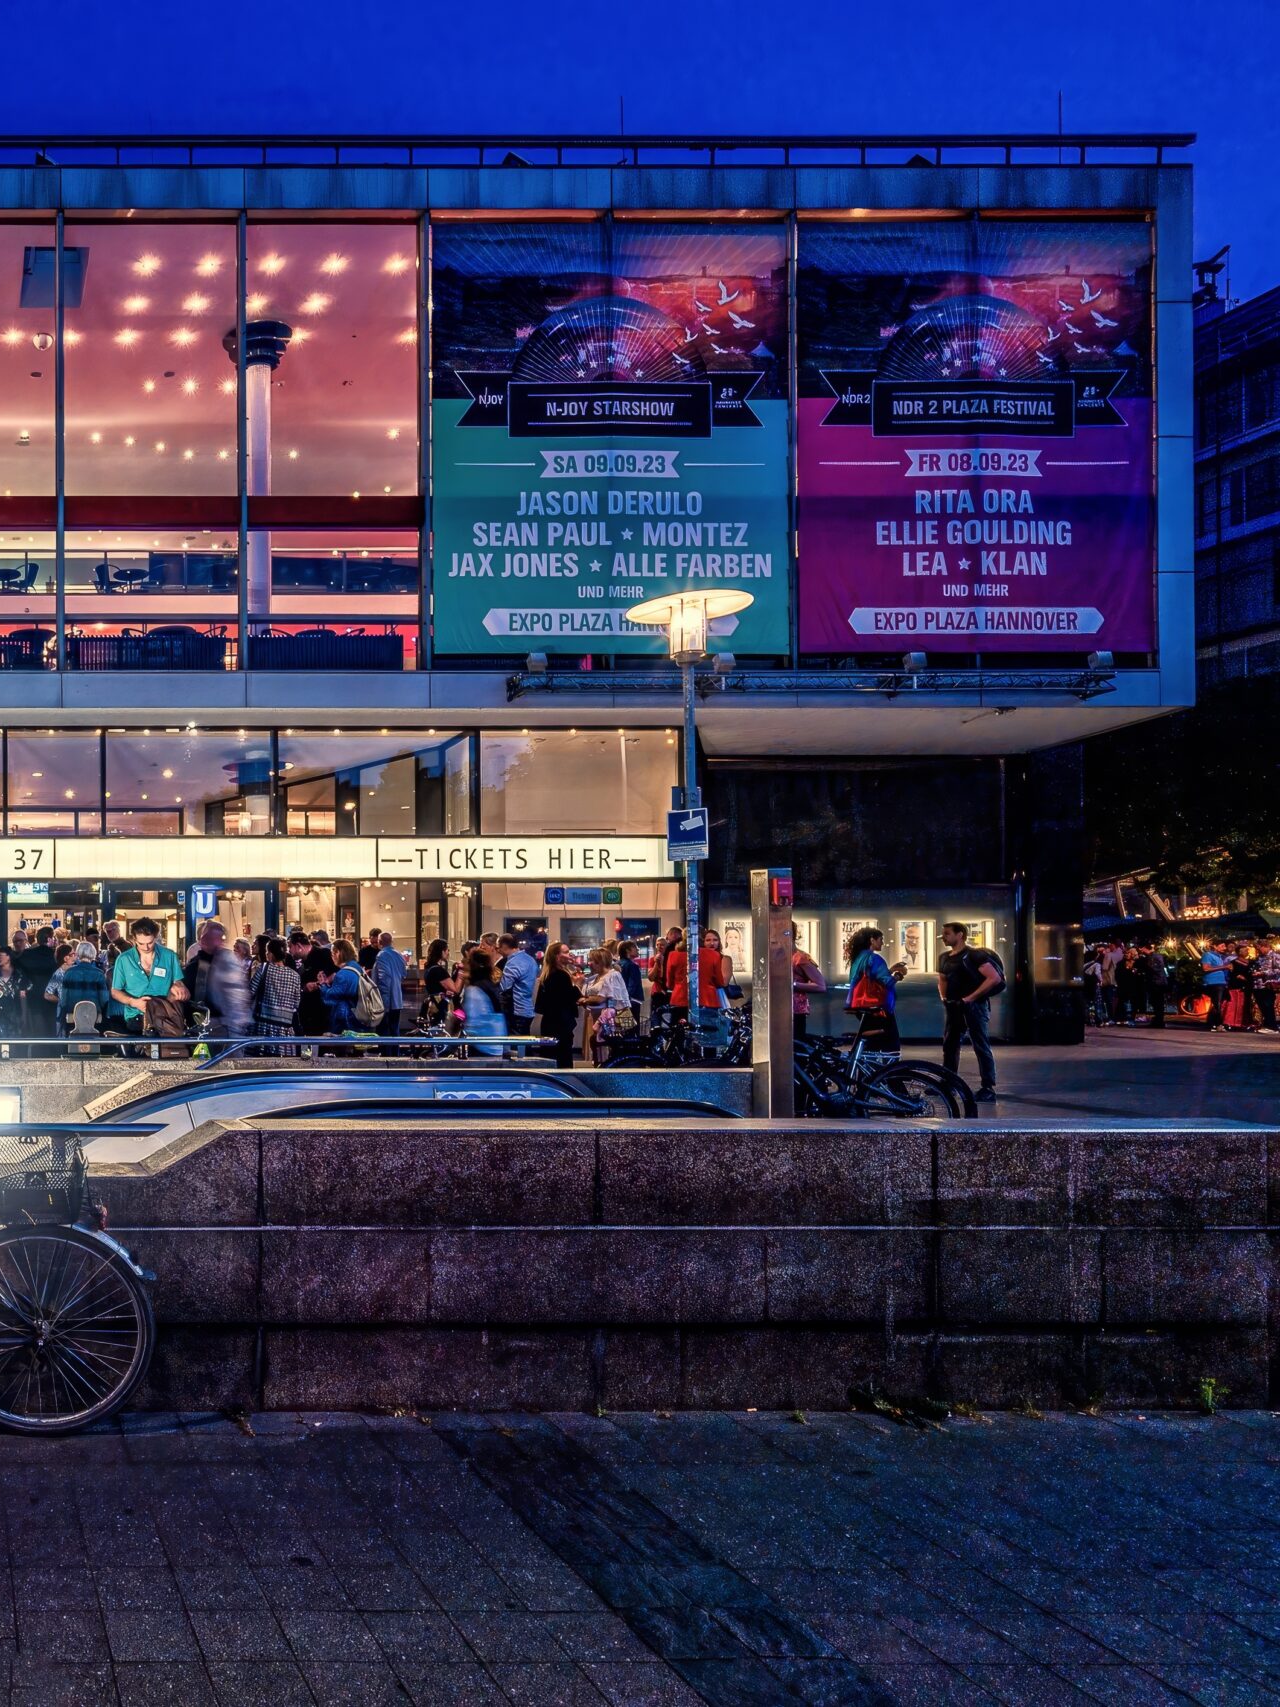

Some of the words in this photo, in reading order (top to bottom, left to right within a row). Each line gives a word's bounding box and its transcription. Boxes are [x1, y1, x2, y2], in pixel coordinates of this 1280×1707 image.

[546, 401, 588, 417] N-JOY
[593, 401, 675, 417] STARSHOW
[892, 400, 924, 416] NDR
[928, 400, 938, 415] 2
[942, 400, 989, 415] PLAZA
[993, 400, 1055, 416] FESTIVAL
[552, 456, 578, 473] SA
[584, 456, 666, 474] 09.09.23
[918, 453, 942, 472] FR
[947, 453, 1029, 473] 08.09.23
[517, 491, 598, 516] JASON
[608, 491, 702, 516] DERULO
[915, 489, 974, 514] RITA
[983, 489, 1034, 514] ORA
[472, 523, 538, 547] SEAN
[547, 523, 613, 547] PAUL
[643, 523, 748, 547] MONTEZ
[876, 521, 938, 546] ELLIE
[947, 520, 1072, 546] GOULDING
[448, 553, 494, 578] JAX
[501, 553, 579, 578] JONES
[612, 553, 667, 578] ALLE
[676, 553, 772, 578] FARBEN
[903, 552, 948, 576] LEA
[981, 551, 1047, 576] KLAN
[578, 586, 604, 598] UND
[609, 586, 643, 599] MEHR
[943, 584, 969, 597] UND
[974, 584, 1009, 597] MEHR
[509, 613, 552, 632] EXPO
[559, 613, 614, 632] PLAZA
[874, 611, 917, 631] EXPO
[924, 611, 979, 631] PLAZA
[984, 611, 1078, 631] HANNOVER
[14, 849, 43, 870] 37
[196, 892, 213, 914] U
